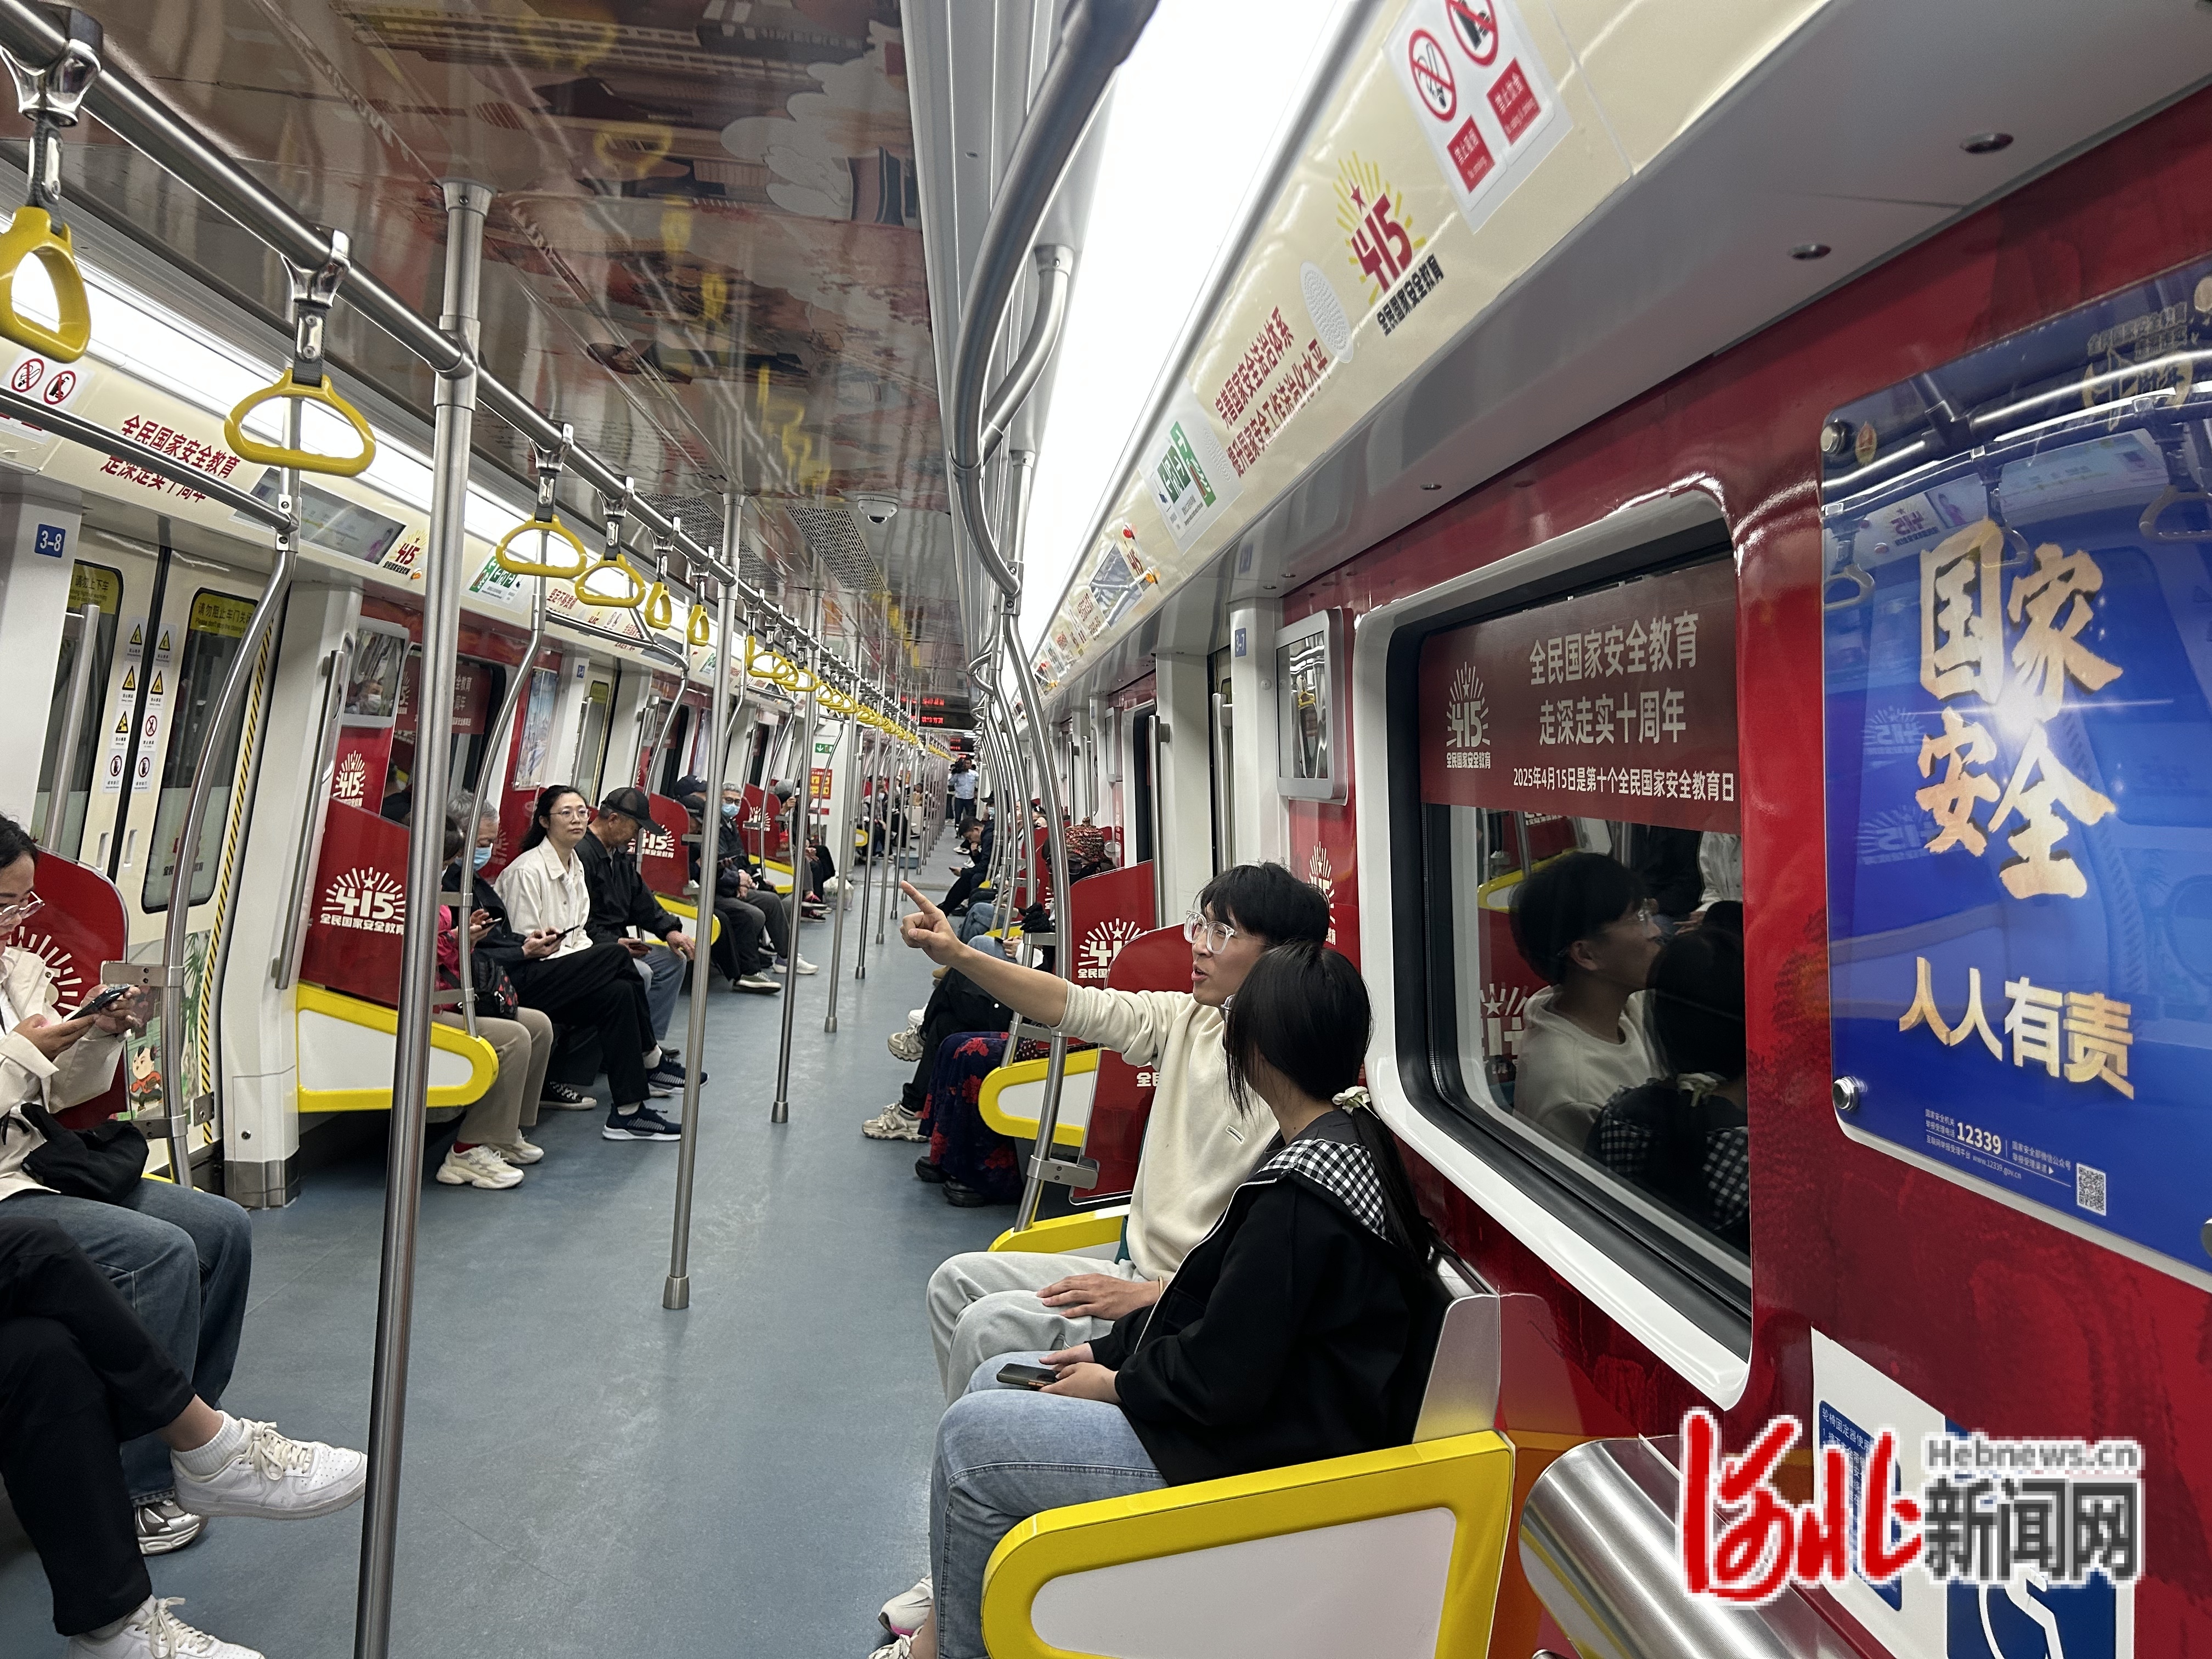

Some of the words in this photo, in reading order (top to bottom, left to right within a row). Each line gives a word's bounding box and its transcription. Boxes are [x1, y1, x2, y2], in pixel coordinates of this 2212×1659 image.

[1351, 193, 1413, 293] 415
[1214, 305, 1295, 431] 完善国家安全法治体系
[121, 415, 241, 479] 全民国家安全教育
[40, 530, 61, 552] 3-8
[395, 543, 421, 565] 415
[1920, 517, 2124, 723] 国家
[1236, 634, 1245, 651] 3-7
[1529, 610, 1699, 685] 全民国家安全教育
[1452, 701, 1482, 747] 415
[1539, 687, 1687, 746] 走深走实十周年
[1446, 752, 1491, 769] 全民国家安全教育
[339, 771, 362, 798] 415
[1513, 766, 1734, 802] 2025年4月15日是第十个全民国家安全教育日
[1915, 707, 2117, 899] 安全
[335, 887, 396, 920] 415
[320, 913, 404, 935] 全民国家安全教育
[1899, 956, 2135, 1101] 人人有责
[1957, 1122, 2002, 1155] 12339
[1973, 1155, 2022, 1180] www.12339.gov.cn
